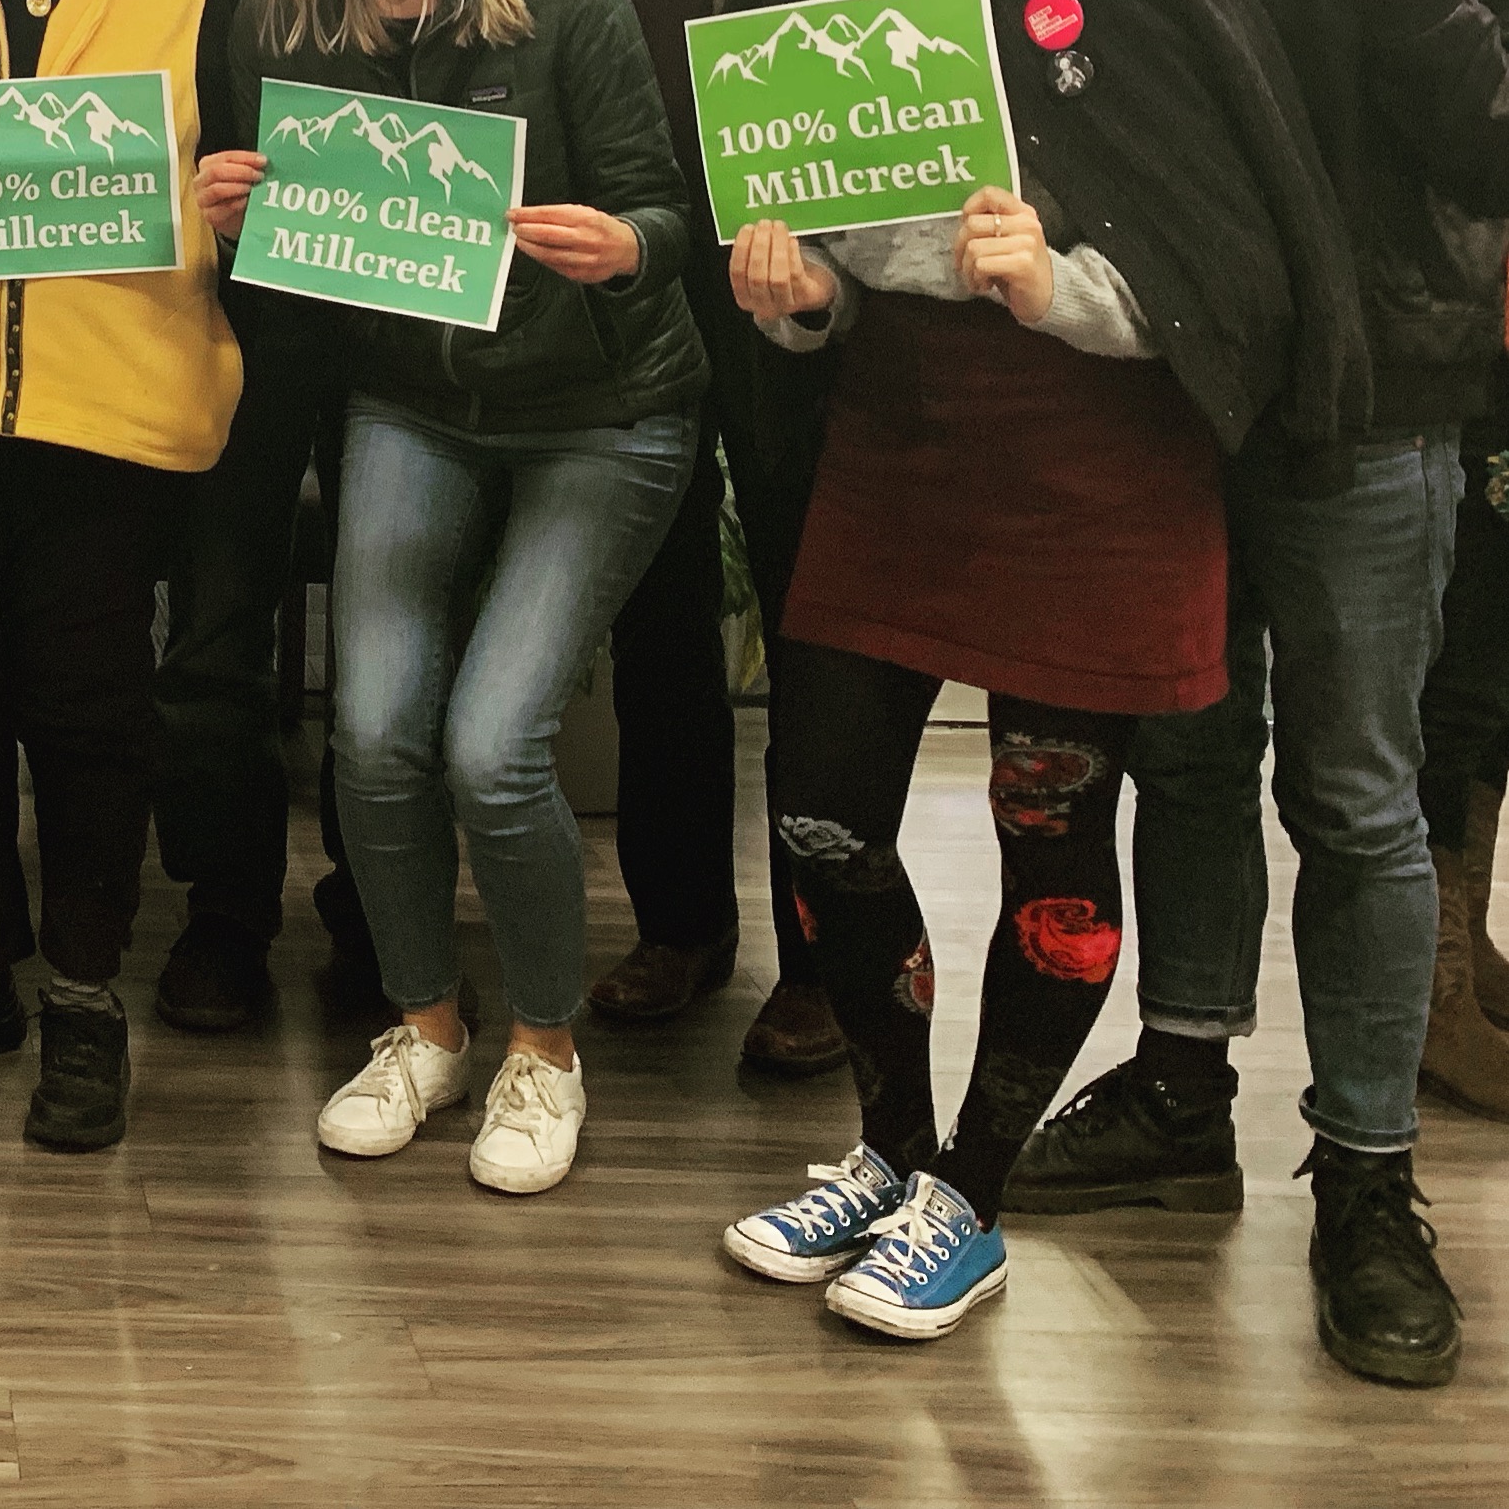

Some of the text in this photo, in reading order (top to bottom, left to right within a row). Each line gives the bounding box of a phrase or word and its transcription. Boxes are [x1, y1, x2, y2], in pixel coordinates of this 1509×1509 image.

[717, 95, 984, 157] 100% Clean
[50, 166, 158, 200] Clean
[743, 144, 976, 209] Millcreek
[262, 181, 492, 247] 100% Clean
[267, 227, 468, 294] Millcreek
